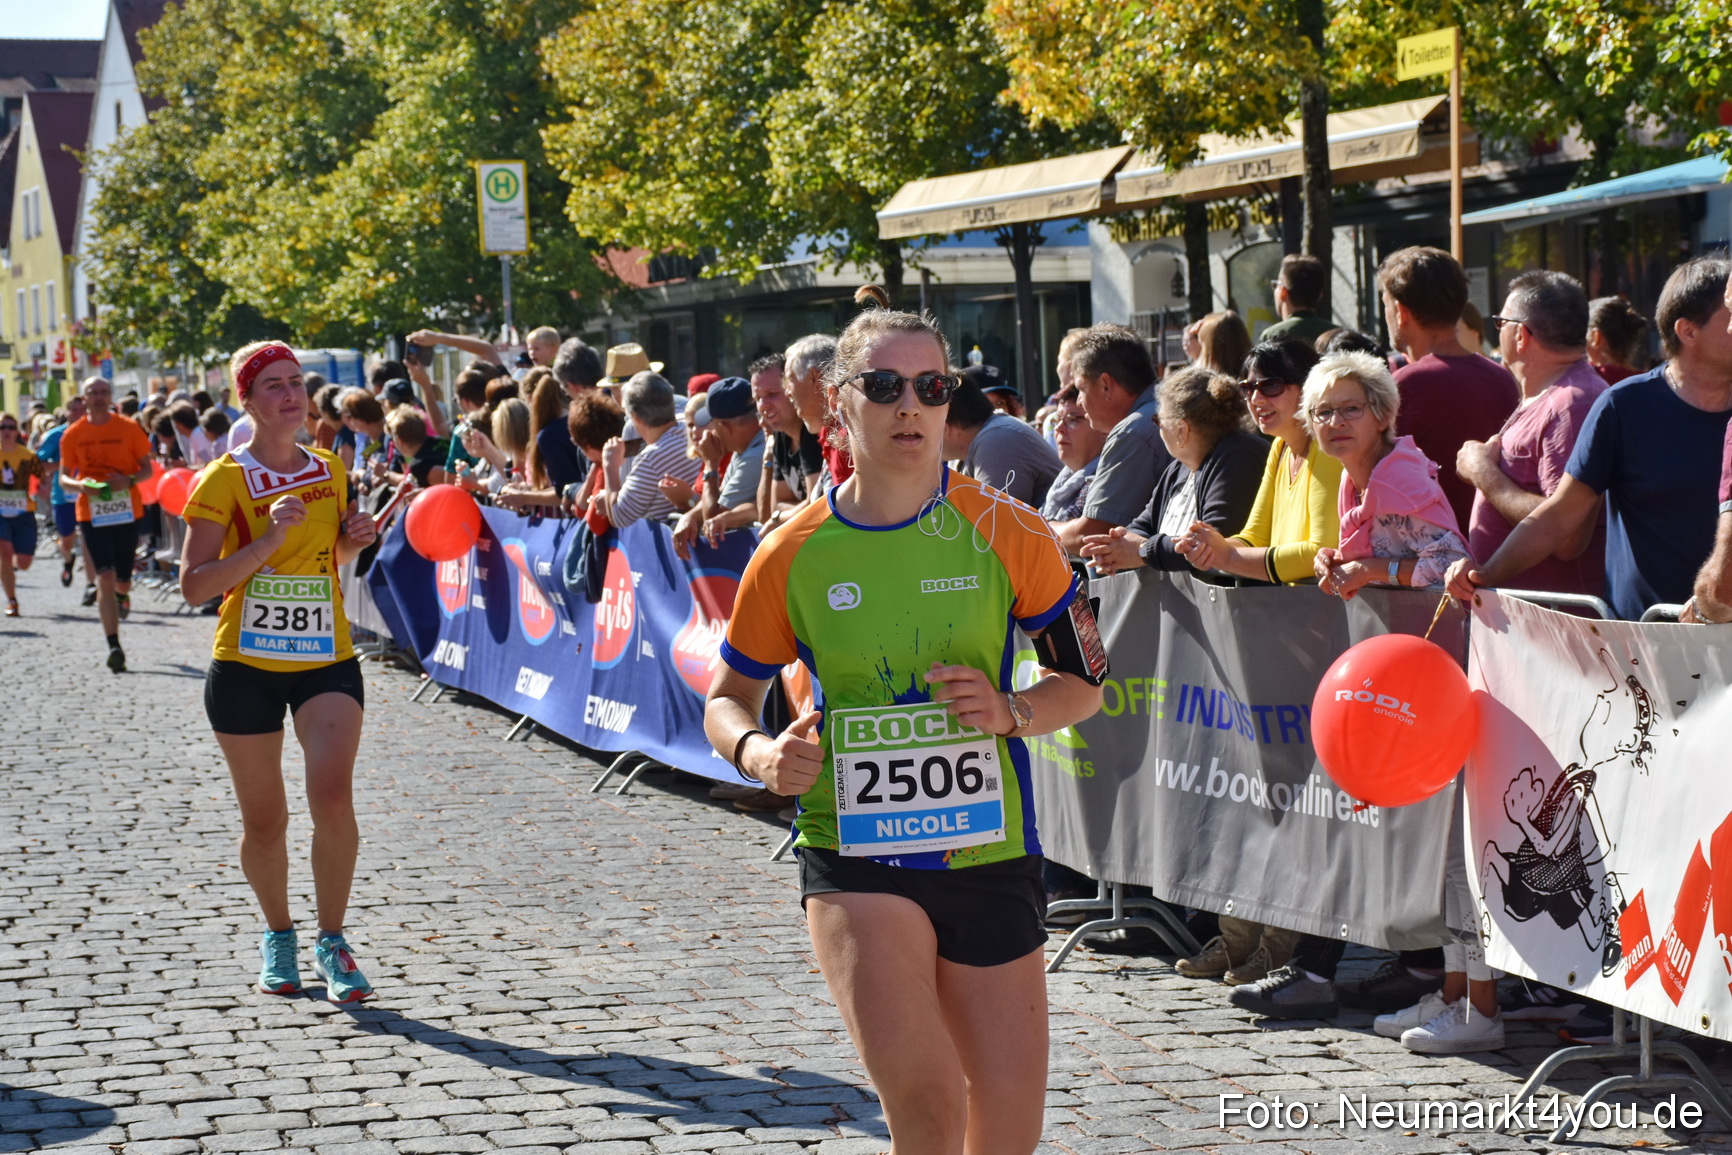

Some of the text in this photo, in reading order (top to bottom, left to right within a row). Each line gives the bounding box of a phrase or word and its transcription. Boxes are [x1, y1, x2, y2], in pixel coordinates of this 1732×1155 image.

[1409, 44, 1452, 66] Toiletten
[301, 486, 336, 504] BÖGL
[95, 501, 127, 515] 2609
[252, 577, 328, 599] BOCK
[921, 576, 980, 594] BOCK
[252, 604, 322, 632] 2381
[1373, 706, 1414, 726] energie
[854, 751, 984, 805] 2506
[876, 811, 971, 838] NICOLE
